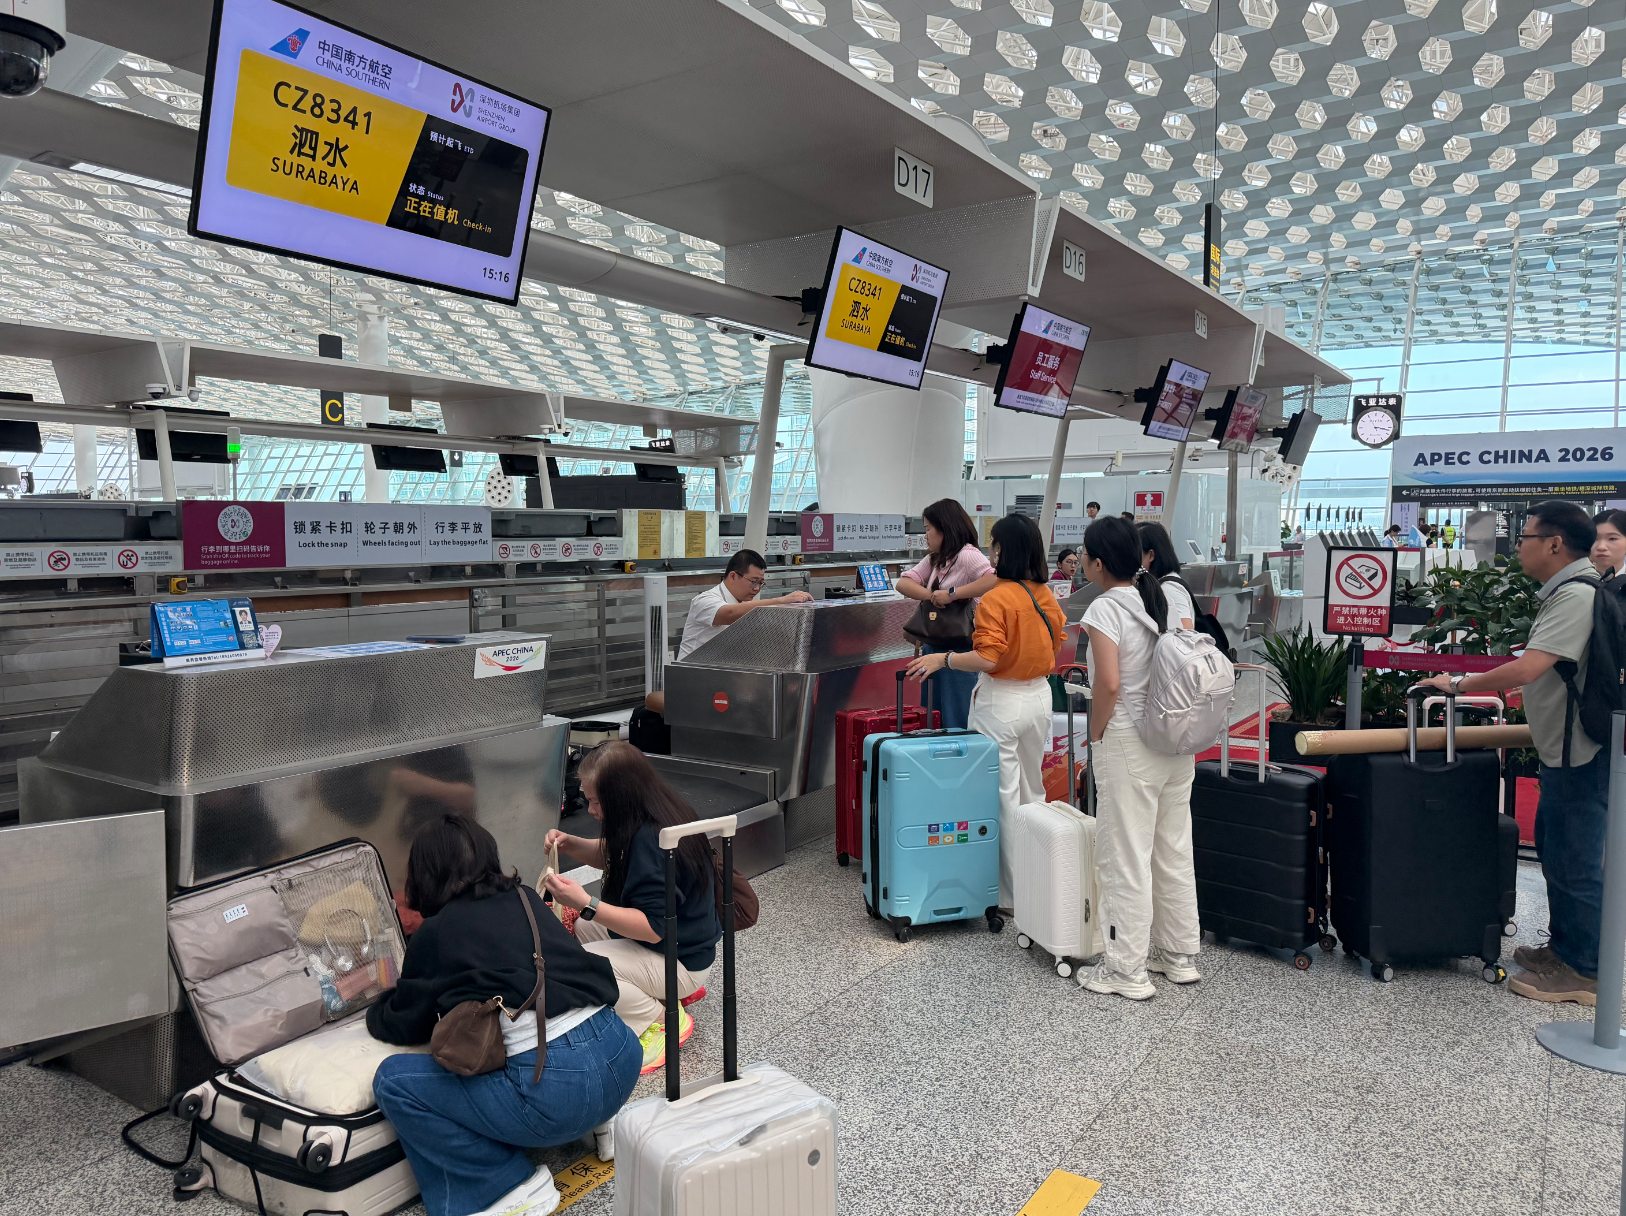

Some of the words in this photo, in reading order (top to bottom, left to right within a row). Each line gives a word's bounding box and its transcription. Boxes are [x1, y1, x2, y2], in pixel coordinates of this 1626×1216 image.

[318, 39, 393, 80] 中国南方航空
[315, 55, 343, 74] CHINA
[345, 66, 391, 91] SOUTHERN
[273, 81, 372, 135] CZ8341
[478, 107, 505, 122] SHENZHEN
[477, 116, 497, 128] AIRPORT
[289, 124, 349, 168] 泗水
[429, 131, 462, 151] 预计起飞
[270, 156, 360, 195] SURABAYA
[898, 155, 930, 198] D17
[408, 183, 425, 196] 状态
[404, 196, 459, 225] 正在值机
[462, 218, 492, 234] Check-in
[1065, 245, 1084, 275] D16
[482, 267, 510, 283] 15:16
[848, 277, 882, 301] CZ8341
[849, 300, 871, 321] 泗水
[841, 318, 871, 335] SURABAYA
[1196, 312, 1207, 335] D15
[885, 332, 906, 347] 正在值机
[1035, 351, 1061, 370] 员工服务
[1030, 369, 1042, 381] Staff
[1040, 371, 1057, 384] Service
[325, 399, 343, 422] C
[1358, 397, 1397, 406] 飞亚达表
[1413, 451, 1472, 467] APEC
[1478, 448, 1551, 465] CHINA
[1557, 446, 1614, 463] 2026
[293, 520, 353, 534] 锁紧卡扣
[364, 521, 418, 534] 轮子朝外
[434, 521, 483, 534] 行李平放
[201, 545, 270, 553] 行李到哪里扫码告诉你
[330, 541, 348, 549] snap
[362, 539, 387, 547] Wheels
[388, 539, 409, 548] facing
[429, 539, 440, 547] Lay
[452, 539, 478, 547] baggage
[1332, 606, 1387, 616] 严禁携带火种
[1336, 616, 1381, 626] 进入控制区
[491, 648, 511, 658] APEC
[511, 645, 534, 655] CHINA
[560, 1179, 595, 1204] Please
